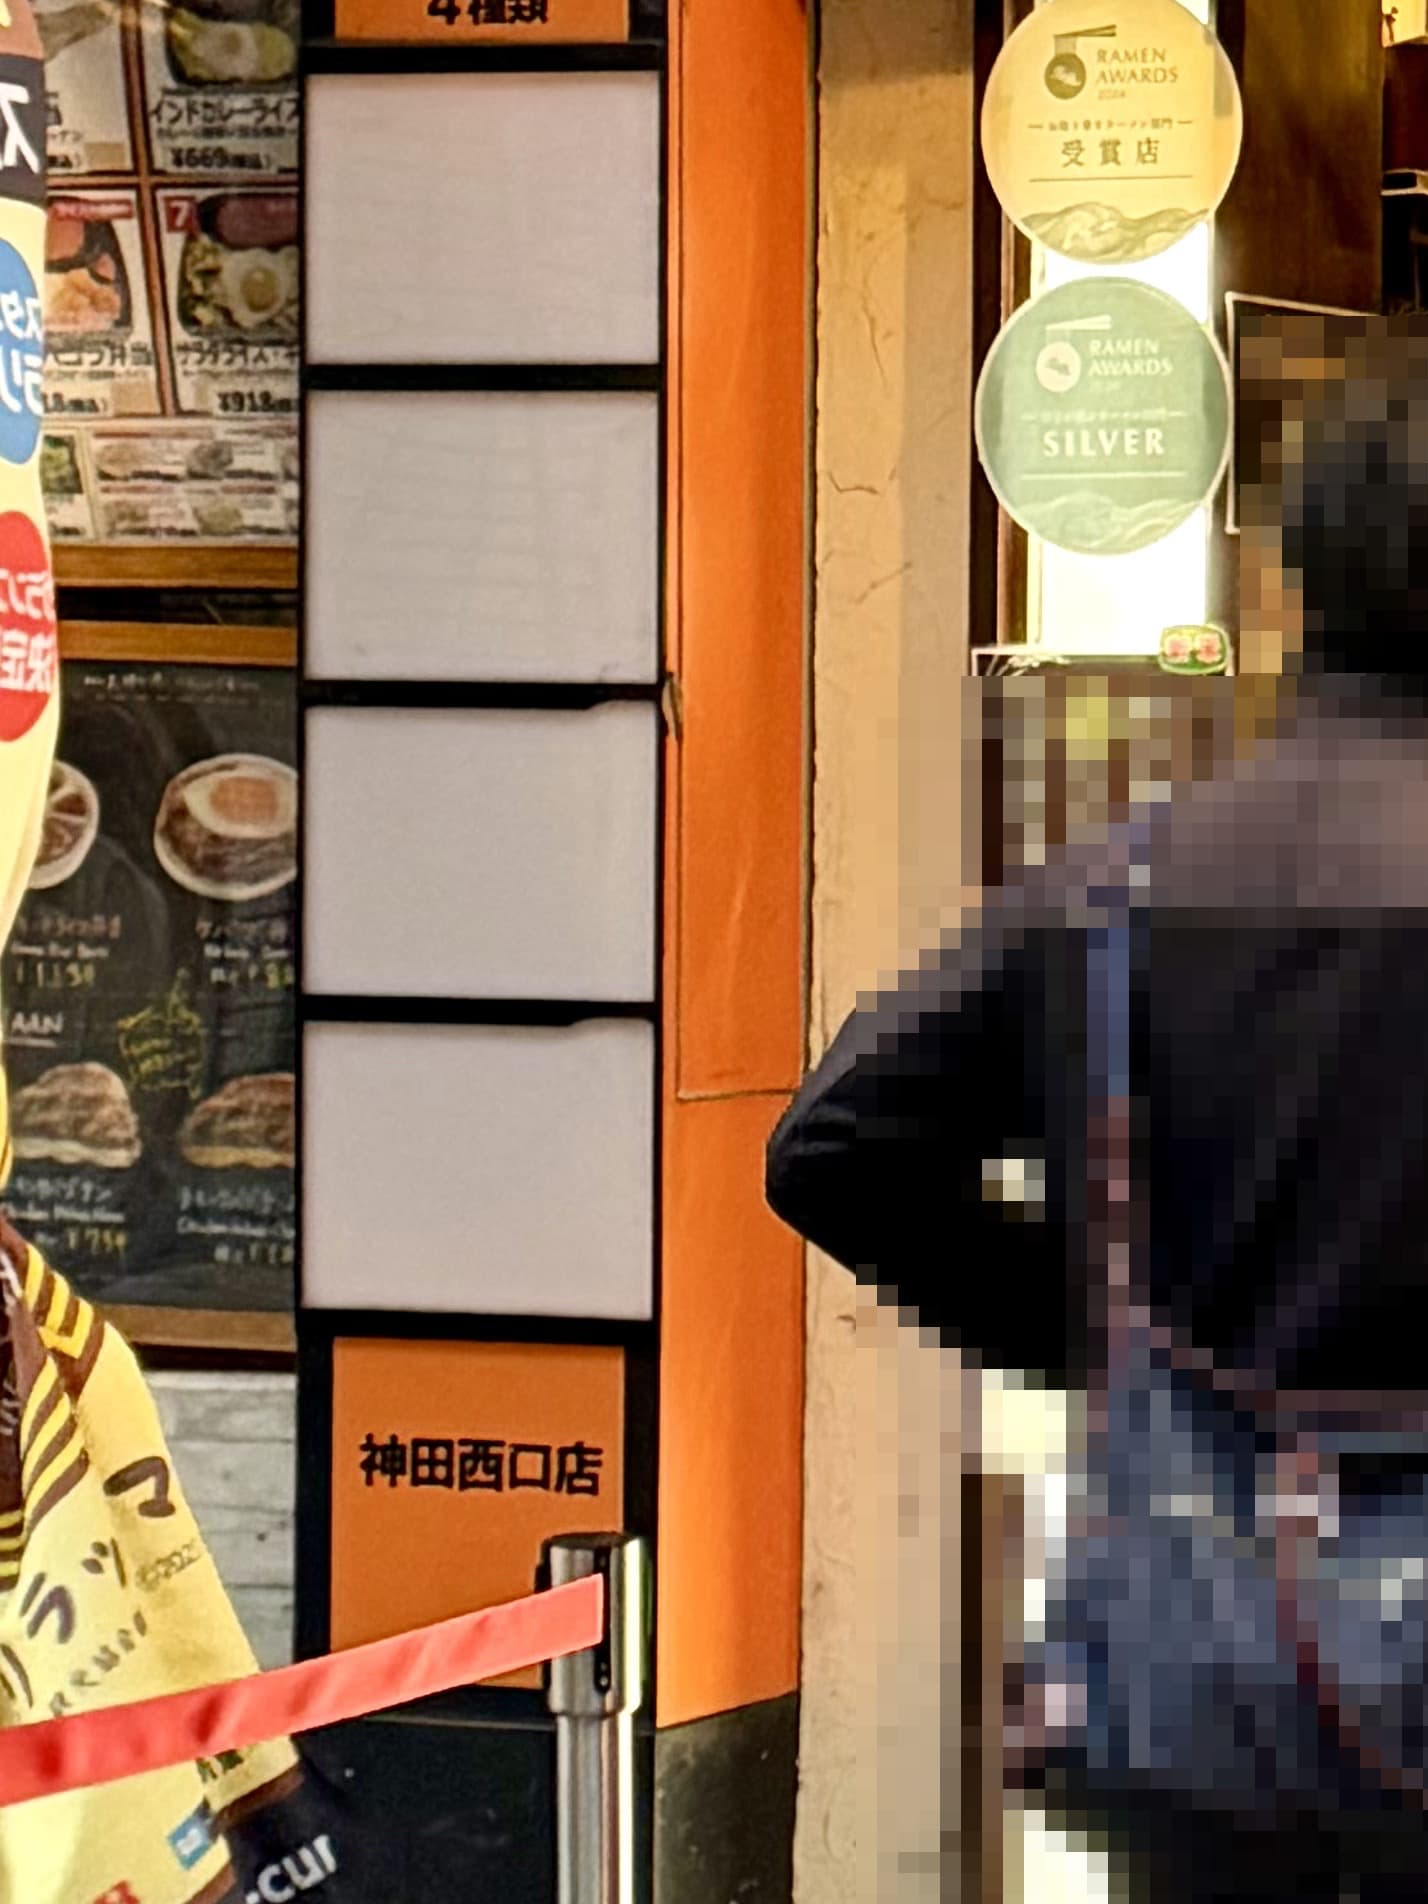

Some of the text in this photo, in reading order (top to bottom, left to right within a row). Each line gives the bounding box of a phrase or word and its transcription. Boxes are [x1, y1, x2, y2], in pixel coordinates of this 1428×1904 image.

[1096, 47, 1167, 65] RAMEN
[1096, 66, 1179, 84] AWARDS
[1061, 136, 1161, 169] 受賞店
[173, 201, 190, 228] 7
[1088, 338, 1160, 356] RAMEN
[1087, 357, 1174, 377] AWARDS
[1042, 427, 1165, 457] SILVER
[358, 1433, 605, 1498] 神田西口店
